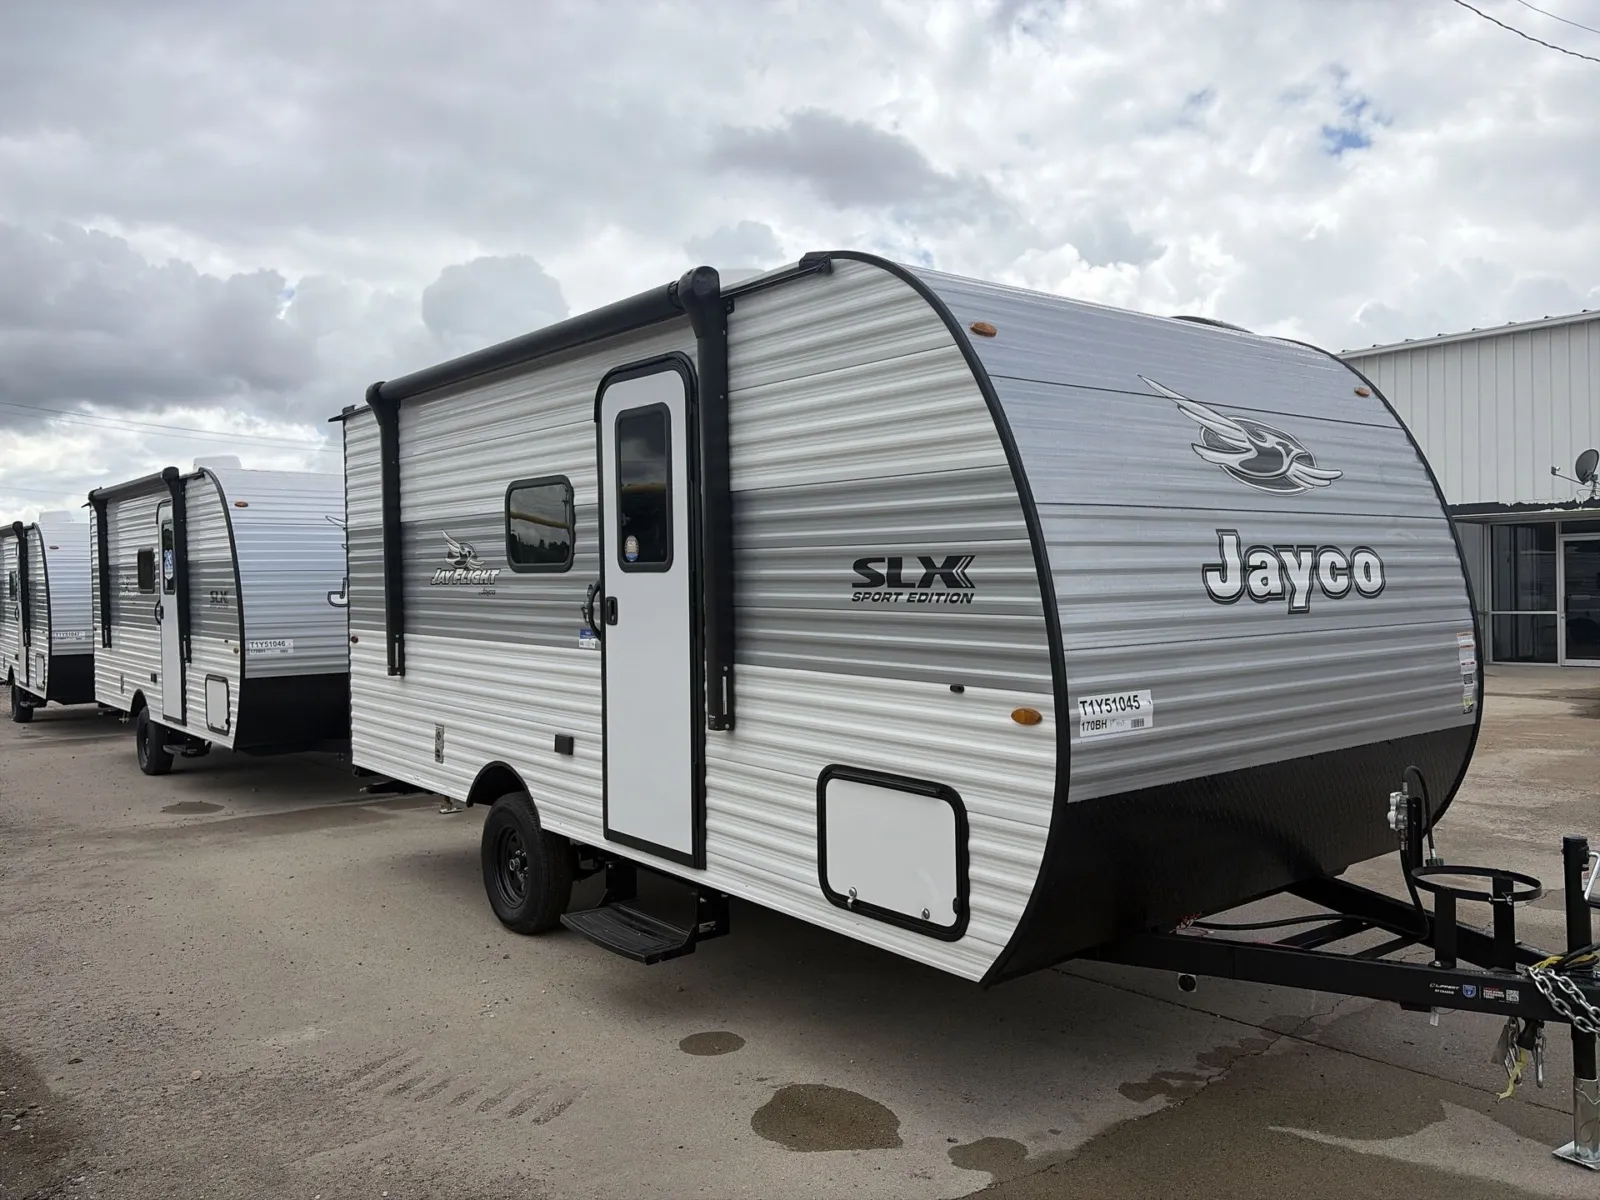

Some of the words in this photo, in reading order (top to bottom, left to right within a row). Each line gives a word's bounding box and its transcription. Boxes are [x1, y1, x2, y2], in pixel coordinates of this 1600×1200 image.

[430, 568, 455, 585] JAY
[451, 568, 501, 585] FLIGHT
[851, 555, 976, 588] SLX
[1202, 529, 1386, 614] Jayco
[851, 591, 904, 603] SPORT
[906, 592, 975, 604] EDITION
[250, 640, 286, 648] T1Y51046
[1079, 694, 1141, 716] T1Y51045
[1081, 719, 1108, 732] 170BH
